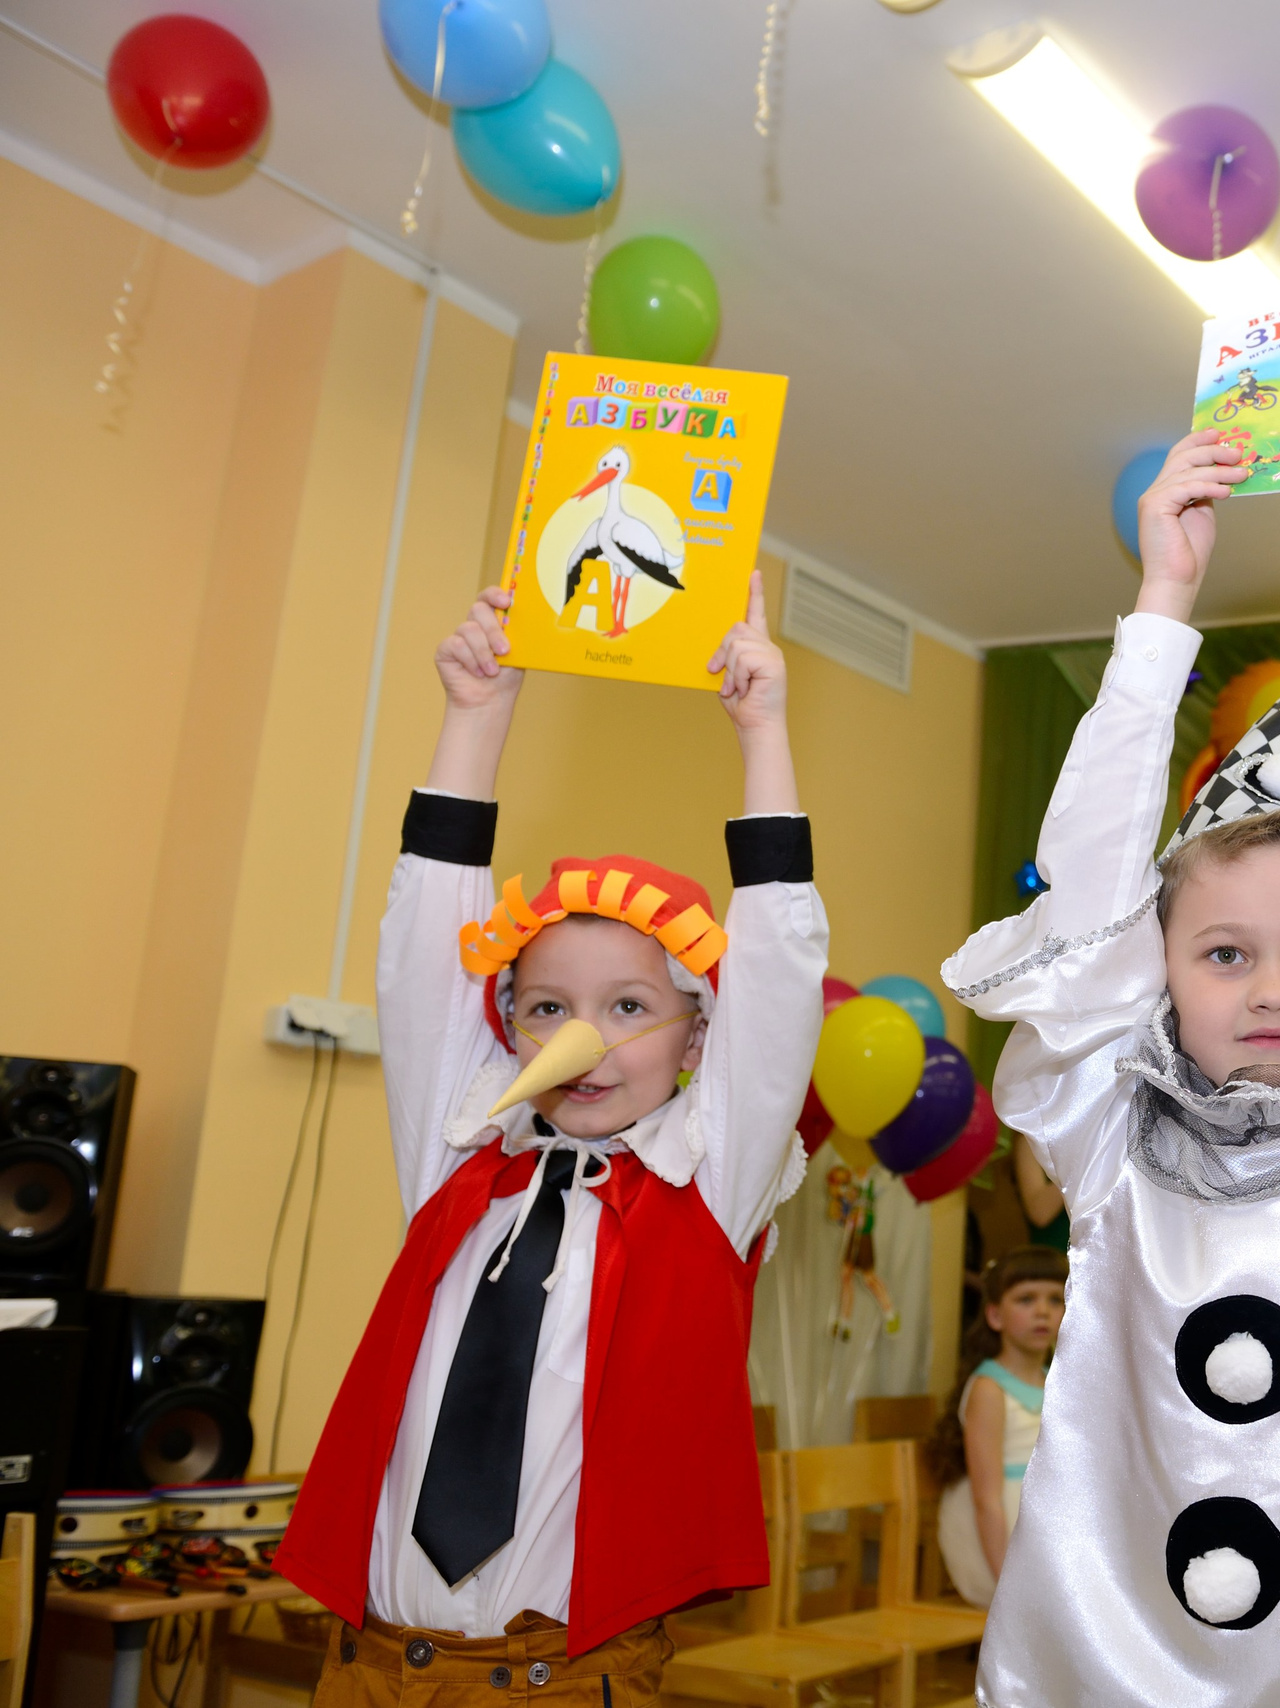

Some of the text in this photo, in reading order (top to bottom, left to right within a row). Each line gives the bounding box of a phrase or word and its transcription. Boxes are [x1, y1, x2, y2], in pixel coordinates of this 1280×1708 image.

[595, 373, 729, 404] Моя весёлая
[569, 402, 738, 439] АЗБУКА
[694, 472, 719, 500] А
[585, 649, 632, 665] hachette
